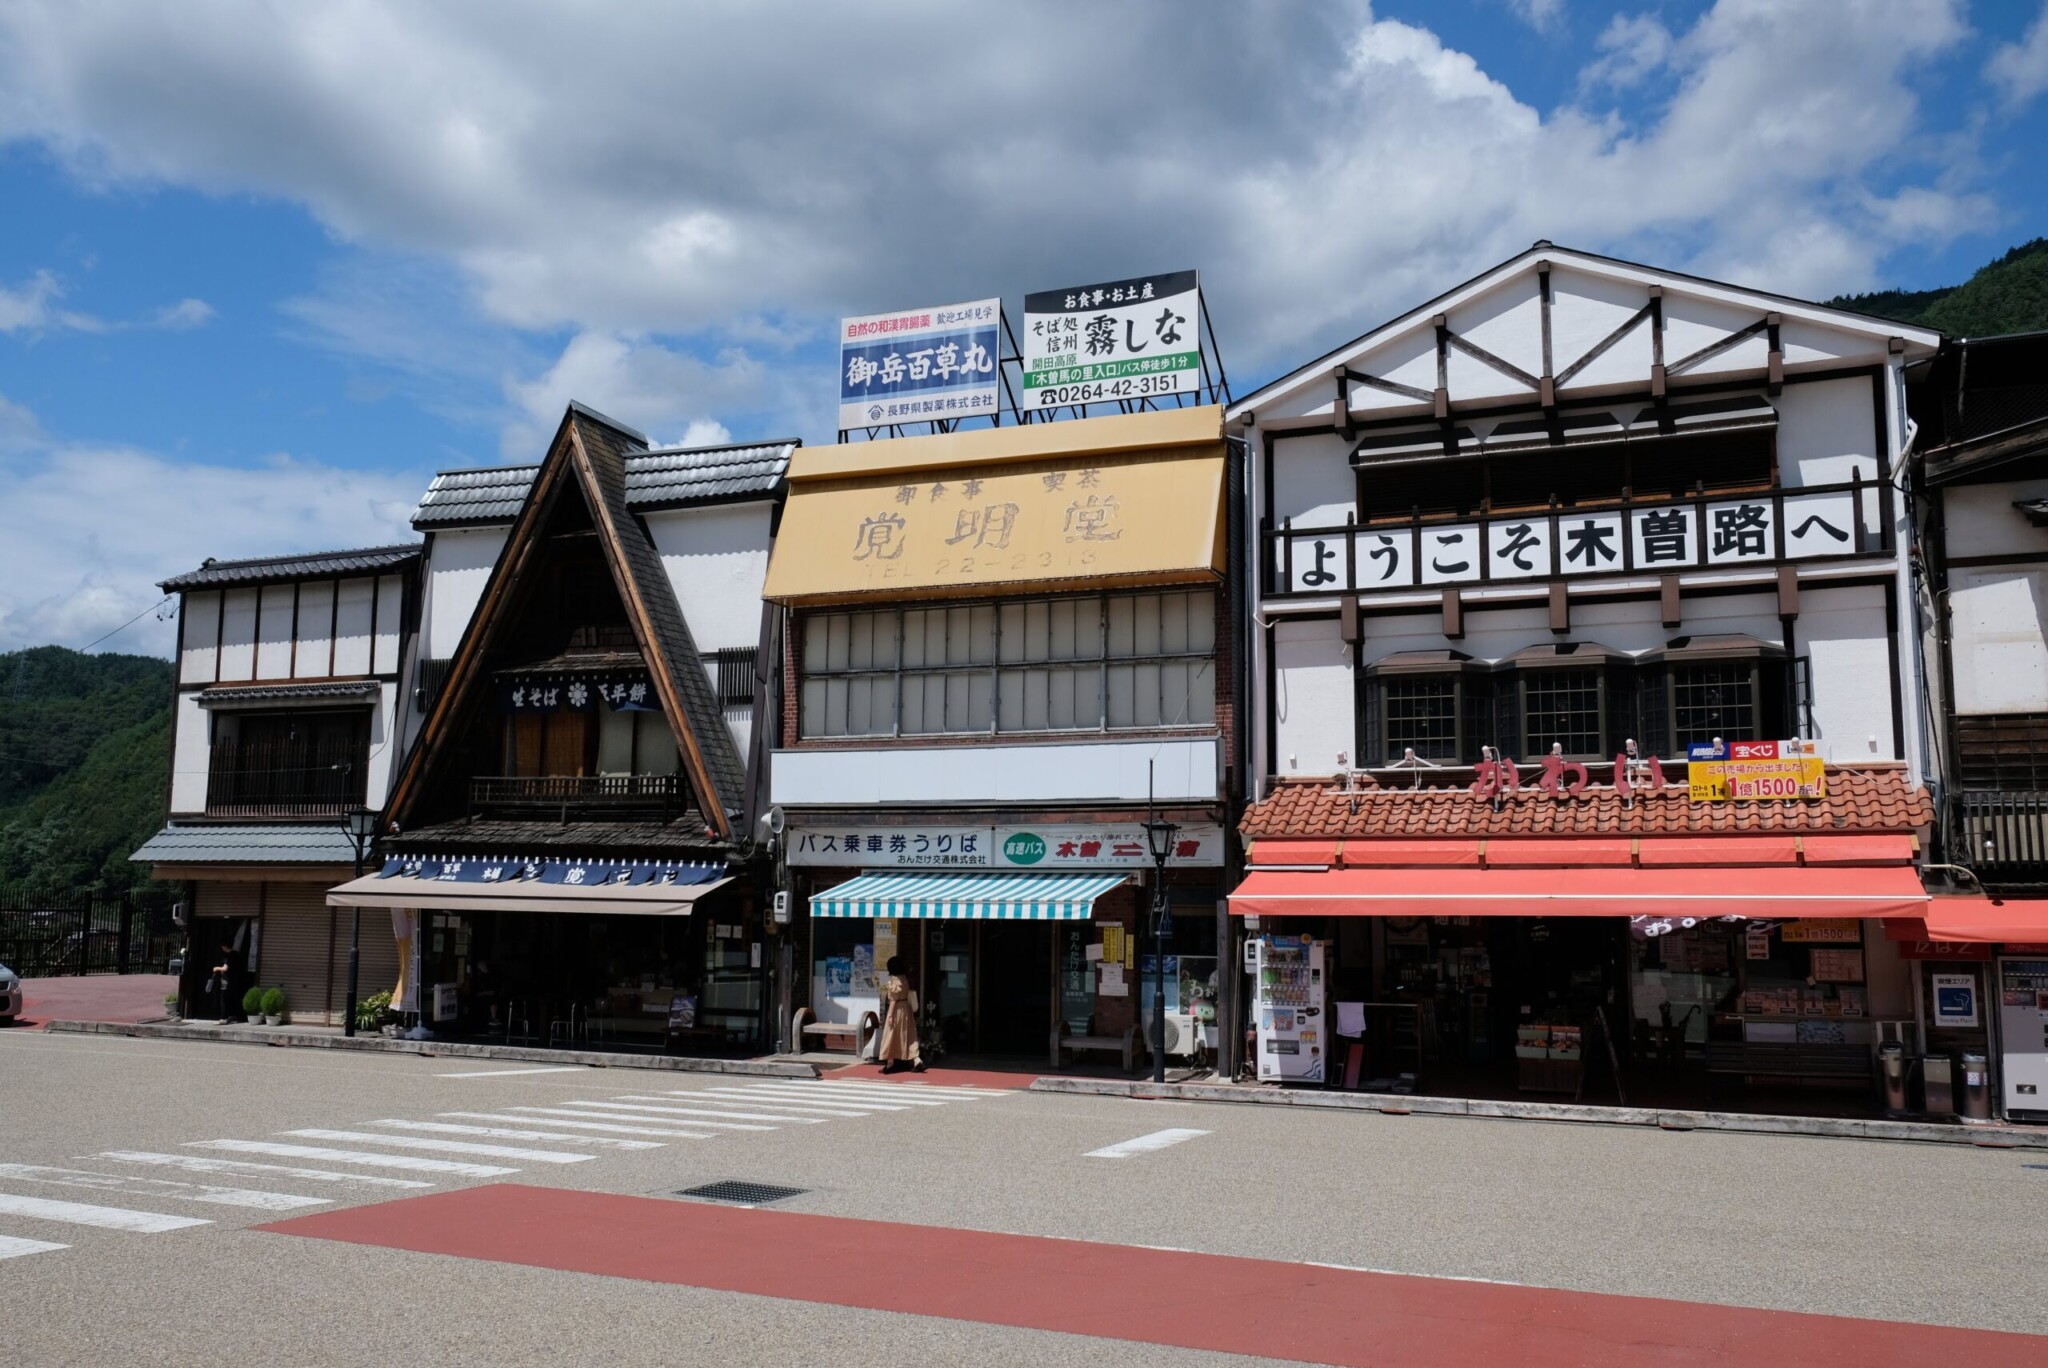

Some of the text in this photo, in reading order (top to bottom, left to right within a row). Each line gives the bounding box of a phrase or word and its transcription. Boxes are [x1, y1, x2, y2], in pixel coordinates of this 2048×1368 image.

[1065, 282, 1155, 309] お食事・お土産
[848, 315, 931, 337] 自然の和漢胃腸薬
[1032, 317, 1078, 336] そば処
[1084, 308, 1186, 356] 霧しな
[1047, 333, 1078, 353] 信州
[846, 342, 993, 388] 御岳百草丸
[1032, 353, 1078, 370] 開田高原
[1058, 374, 1178, 403] 0264-42-3151
[888, 394, 993, 417] 長野県製薬株式会社
[852, 494, 1124, 561] 覚明堂
[1301, 504, 1849, 587] ようこそ木曽路へ
[1735, 745, 1773, 758] 宝くじ
[799, 834, 978, 853] バス乗車券うりば
[1005, 841, 1044, 855] 高速バス
[1070, 931, 1081, 990] おんたけ交通
